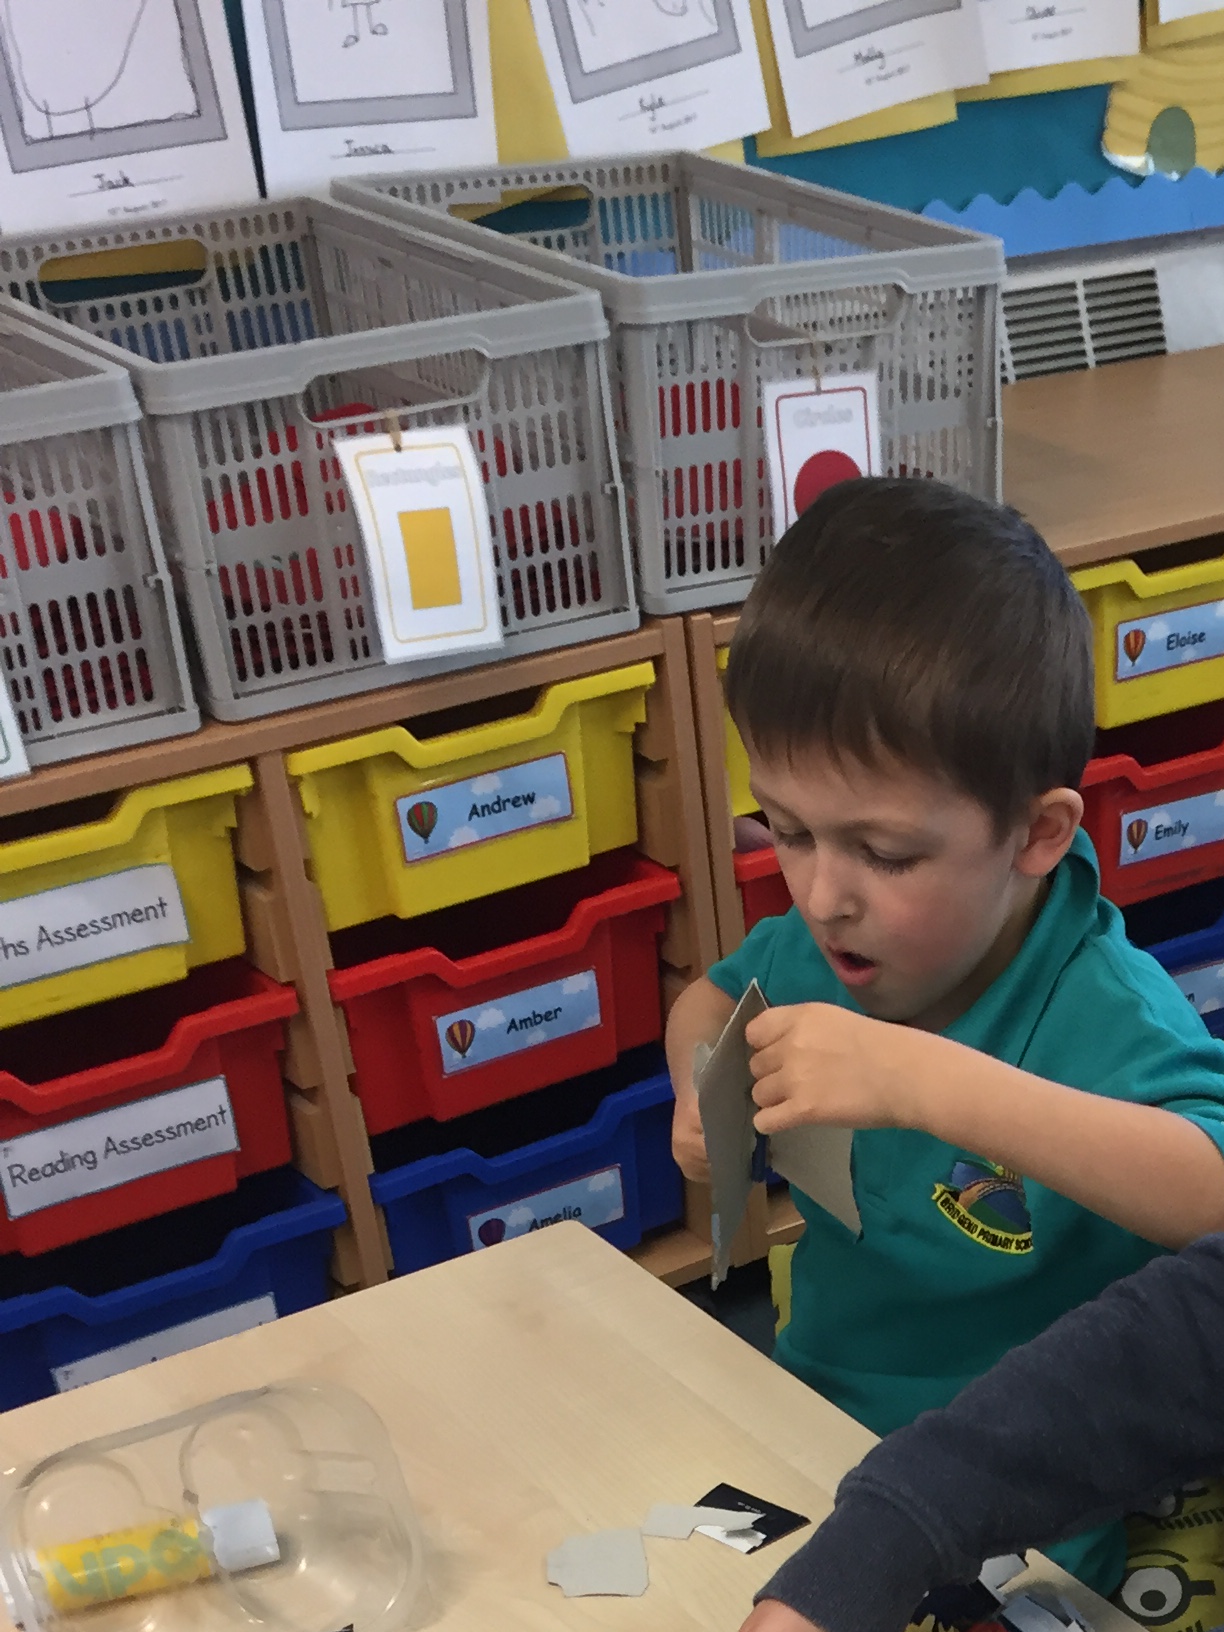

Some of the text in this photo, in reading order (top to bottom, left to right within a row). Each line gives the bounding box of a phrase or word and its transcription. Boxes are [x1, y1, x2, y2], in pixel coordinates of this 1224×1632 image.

[1166, 631, 1206, 651] Eloise
[468, 791, 536, 821] Andrew
[1154, 820, 1190, 840] Emily
[0, 896, 168, 960] hs Assessment
[506, 1006, 562, 1035] Amber
[7, 1104, 227, 1188] Reading Assessment
[529, 1206, 582, 1232] Amelia
